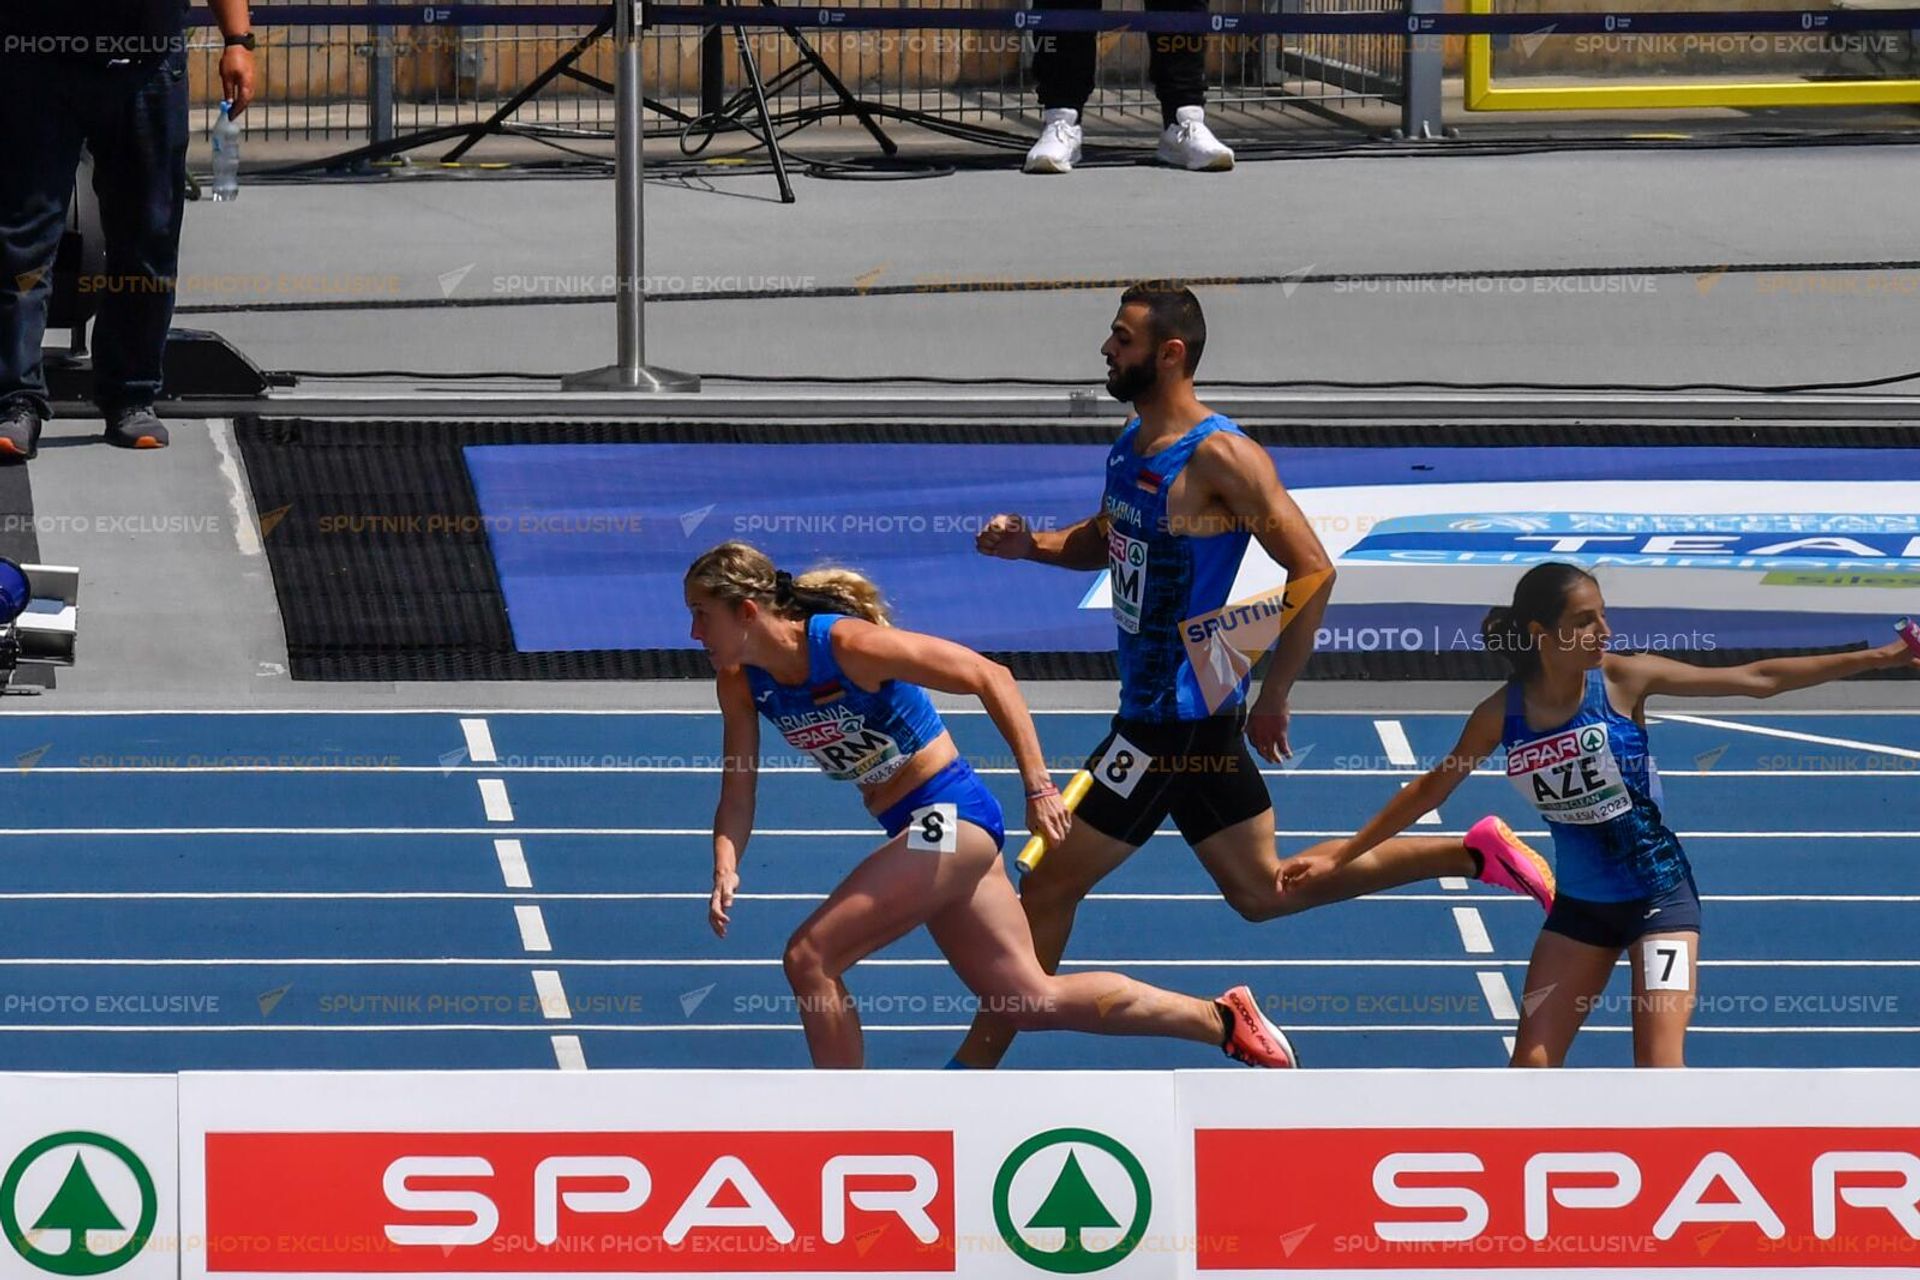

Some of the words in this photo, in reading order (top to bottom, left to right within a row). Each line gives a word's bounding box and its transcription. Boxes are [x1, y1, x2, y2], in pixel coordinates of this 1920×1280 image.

[1513, 535, 1920, 558] TEA
[1111, 558, 1139, 603] RM
[1106, 749, 1135, 784] 8
[1508, 737, 1578, 774] SPAR
[1532, 757, 1606, 802] AZE
[1600, 796, 1629, 817] 2023
[921, 811, 944, 843] 8
[1656, 948, 1678, 982] 7
[382, 1155, 940, 1245] SPAR
[1372, 1151, 1920, 1241] SPAR
